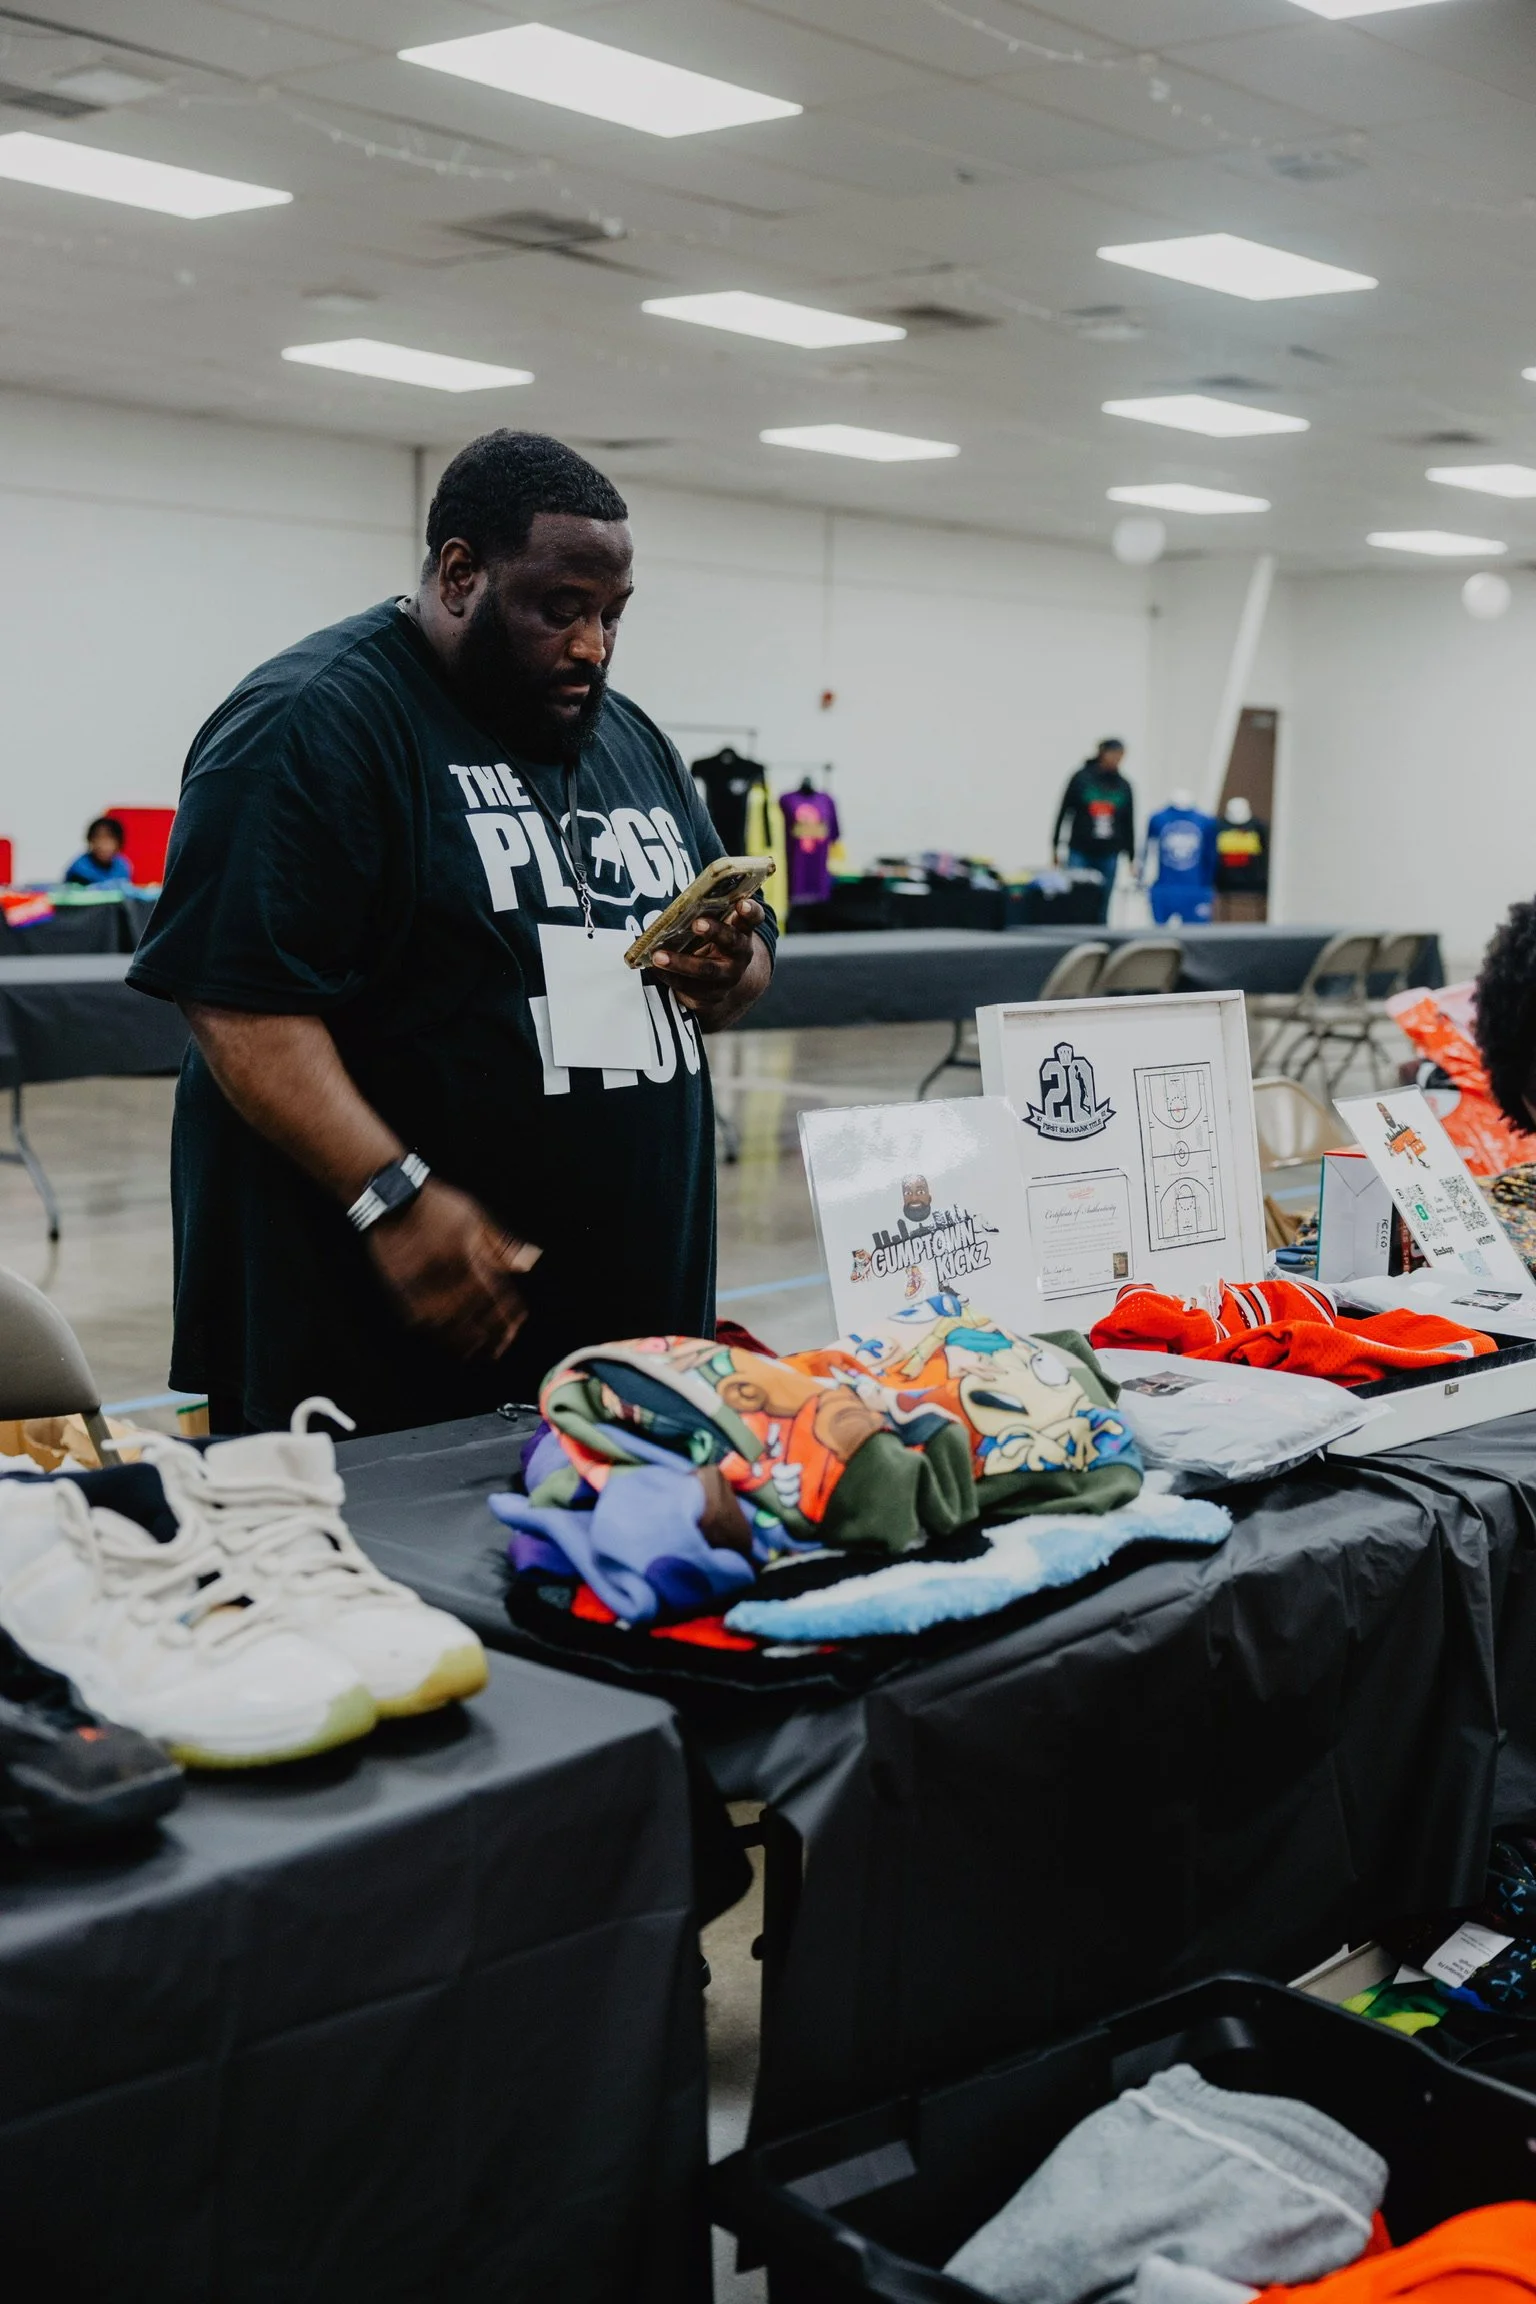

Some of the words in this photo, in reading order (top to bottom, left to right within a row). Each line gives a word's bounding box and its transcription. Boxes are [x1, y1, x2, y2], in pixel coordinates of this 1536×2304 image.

[448, 763, 532, 809] THE
[1041, 1060, 1094, 1123] 20
[1042, 1121, 1059, 1133] FIRST
[871, 1218, 977, 1278] GUMPTOWN
[934, 1241, 992, 1284] KICKZ
